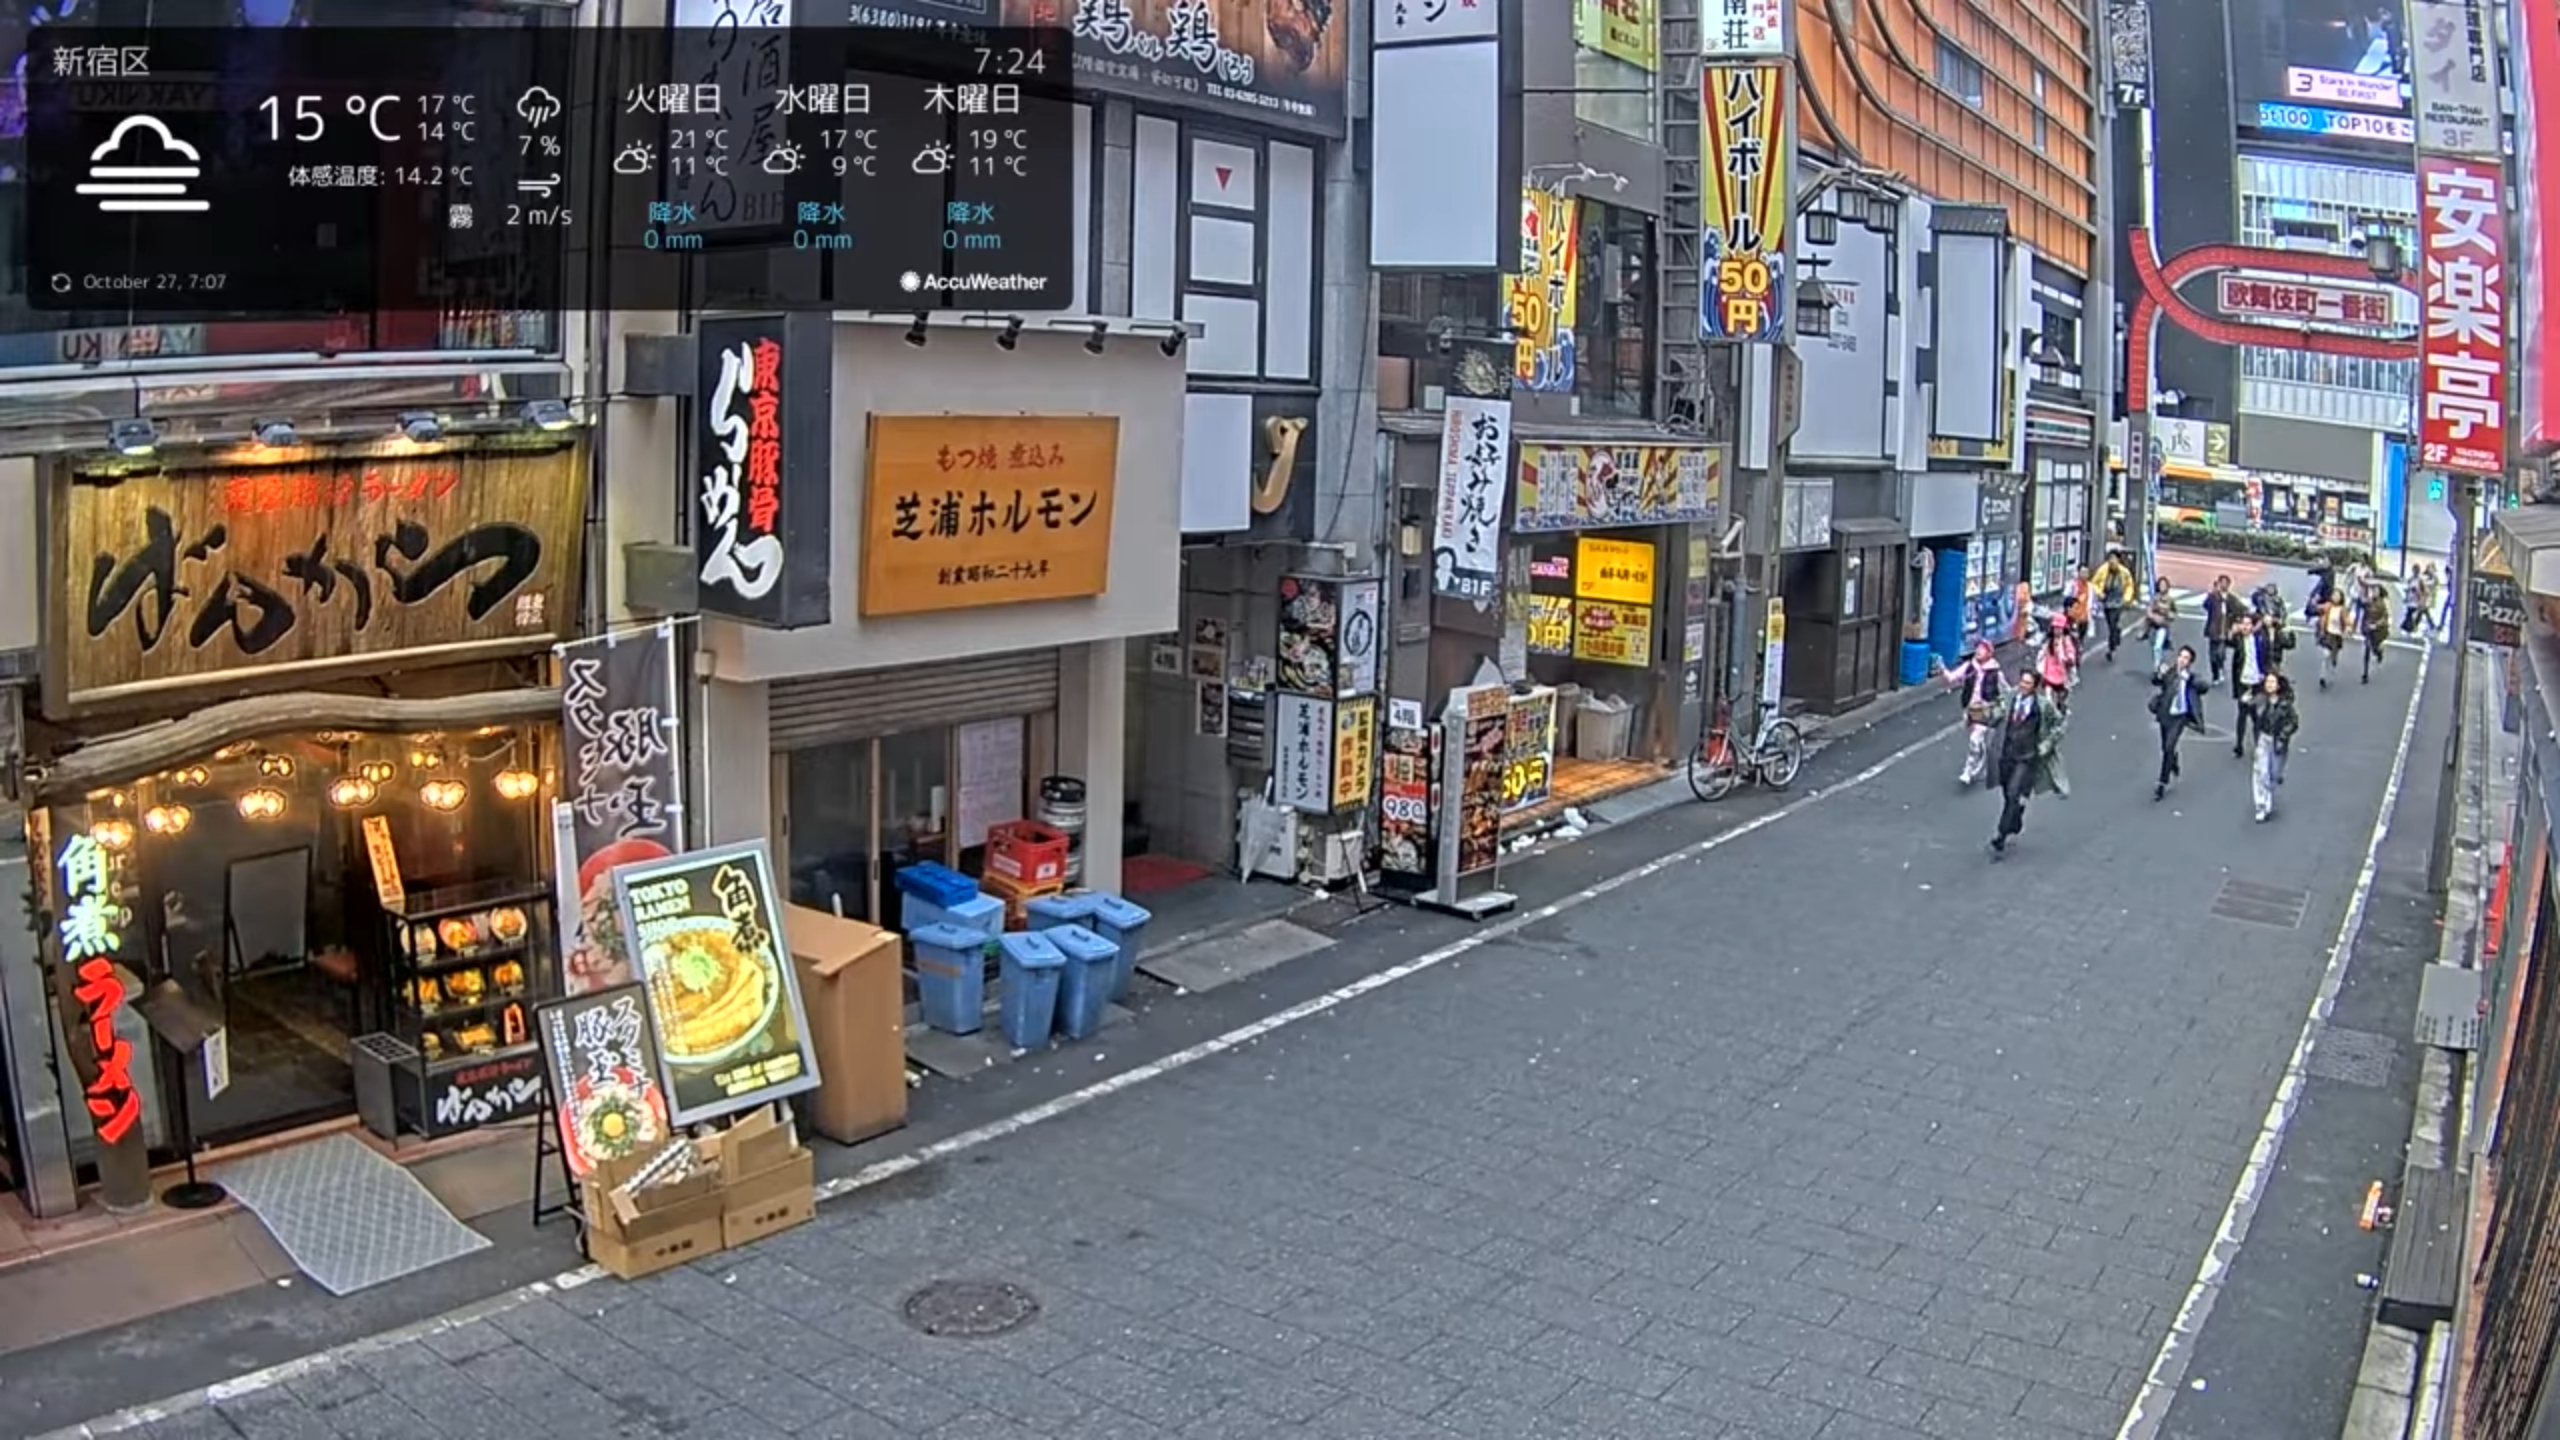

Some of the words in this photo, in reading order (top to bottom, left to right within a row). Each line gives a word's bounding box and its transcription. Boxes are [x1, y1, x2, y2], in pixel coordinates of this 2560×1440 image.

[2118, 83, 2146, 104] 7F
[2296, 73, 2313, 92] 3
[2443, 129, 2473, 148] 3F
[1727, 71, 1761, 253] ハイボール
[2226, 281, 2385, 322] 歌舞伎町一番街
[2426, 167, 2500, 440] 安楽亭
[747, 337, 782, 533] 東京豚骨
[934, 443, 999, 473] もつ焼
[1007, 442, 1066, 470] 煮込み
[2424, 443, 2449, 463] 2F
[1459, 411, 1502, 553] お好み焼き
[891, 487, 1098, 541] 芝浦ホルモン
[87, 505, 543, 655] ばんから
[937, 562, 1051, 587] 創業昭和二十九年
[1460, 576, 1492, 598] B1F
[630, 877, 689, 900] TOKYO
[632, 895, 692, 921] RAMEN
